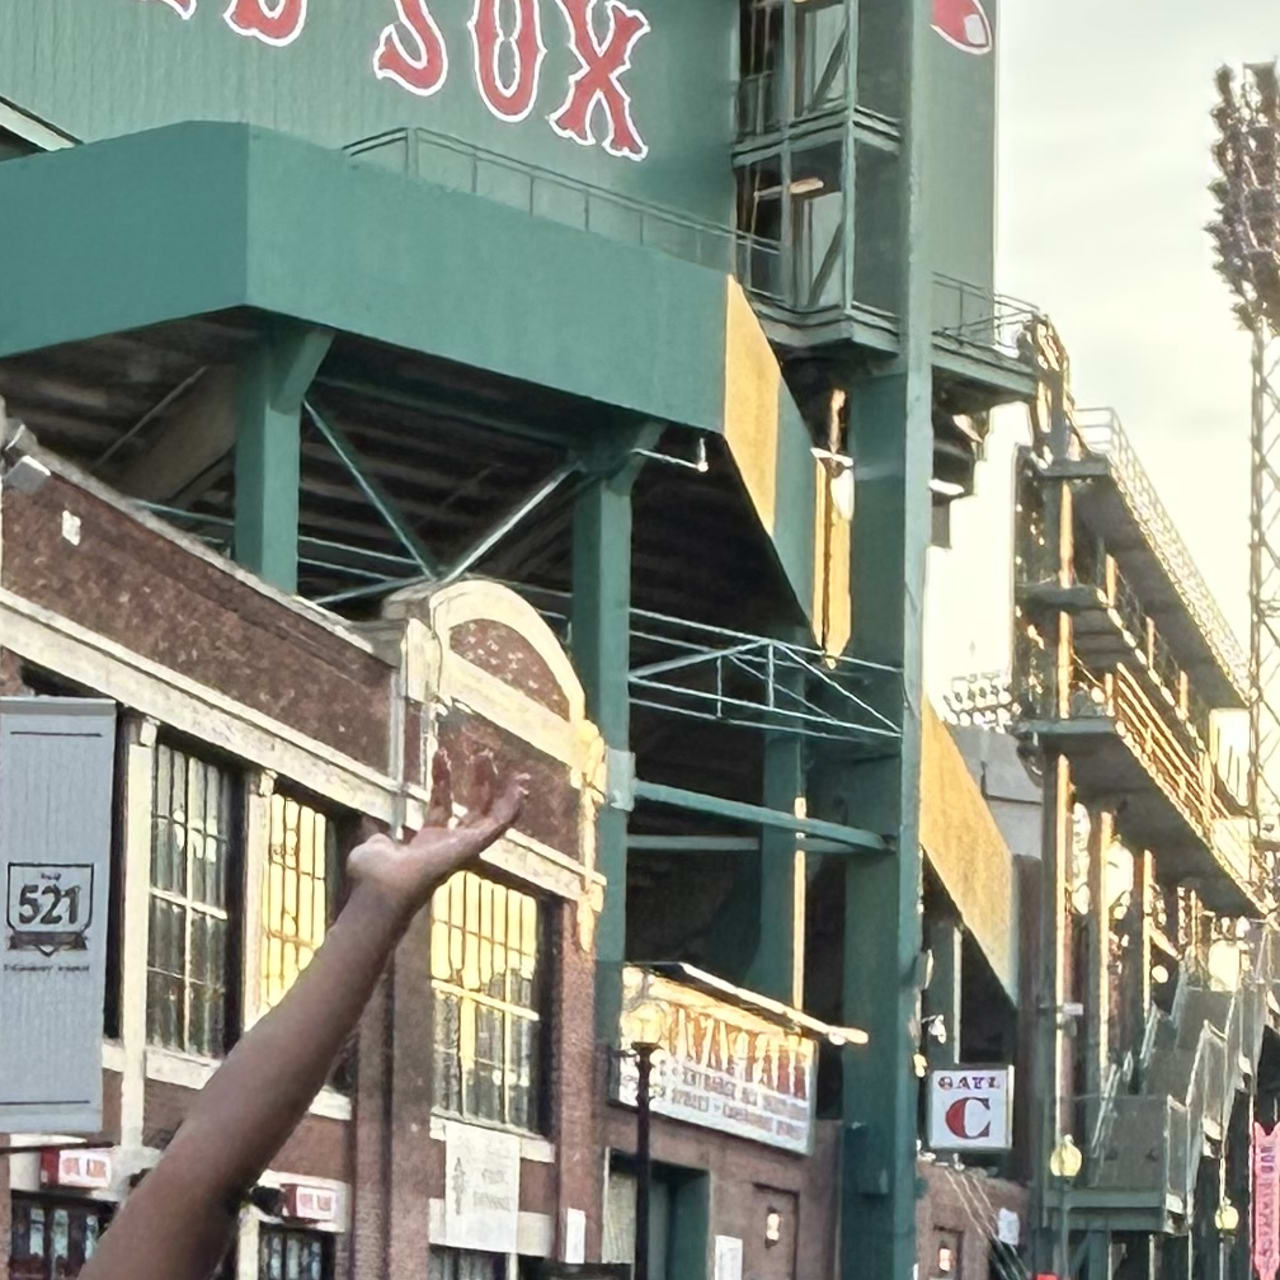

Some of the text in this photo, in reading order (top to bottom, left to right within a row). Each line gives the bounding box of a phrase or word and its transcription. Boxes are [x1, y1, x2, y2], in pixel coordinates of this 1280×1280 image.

[373, 0, 650, 161] SOX
[18, 884, 81, 924] 521
[945, 1096, 991, 1139] C
